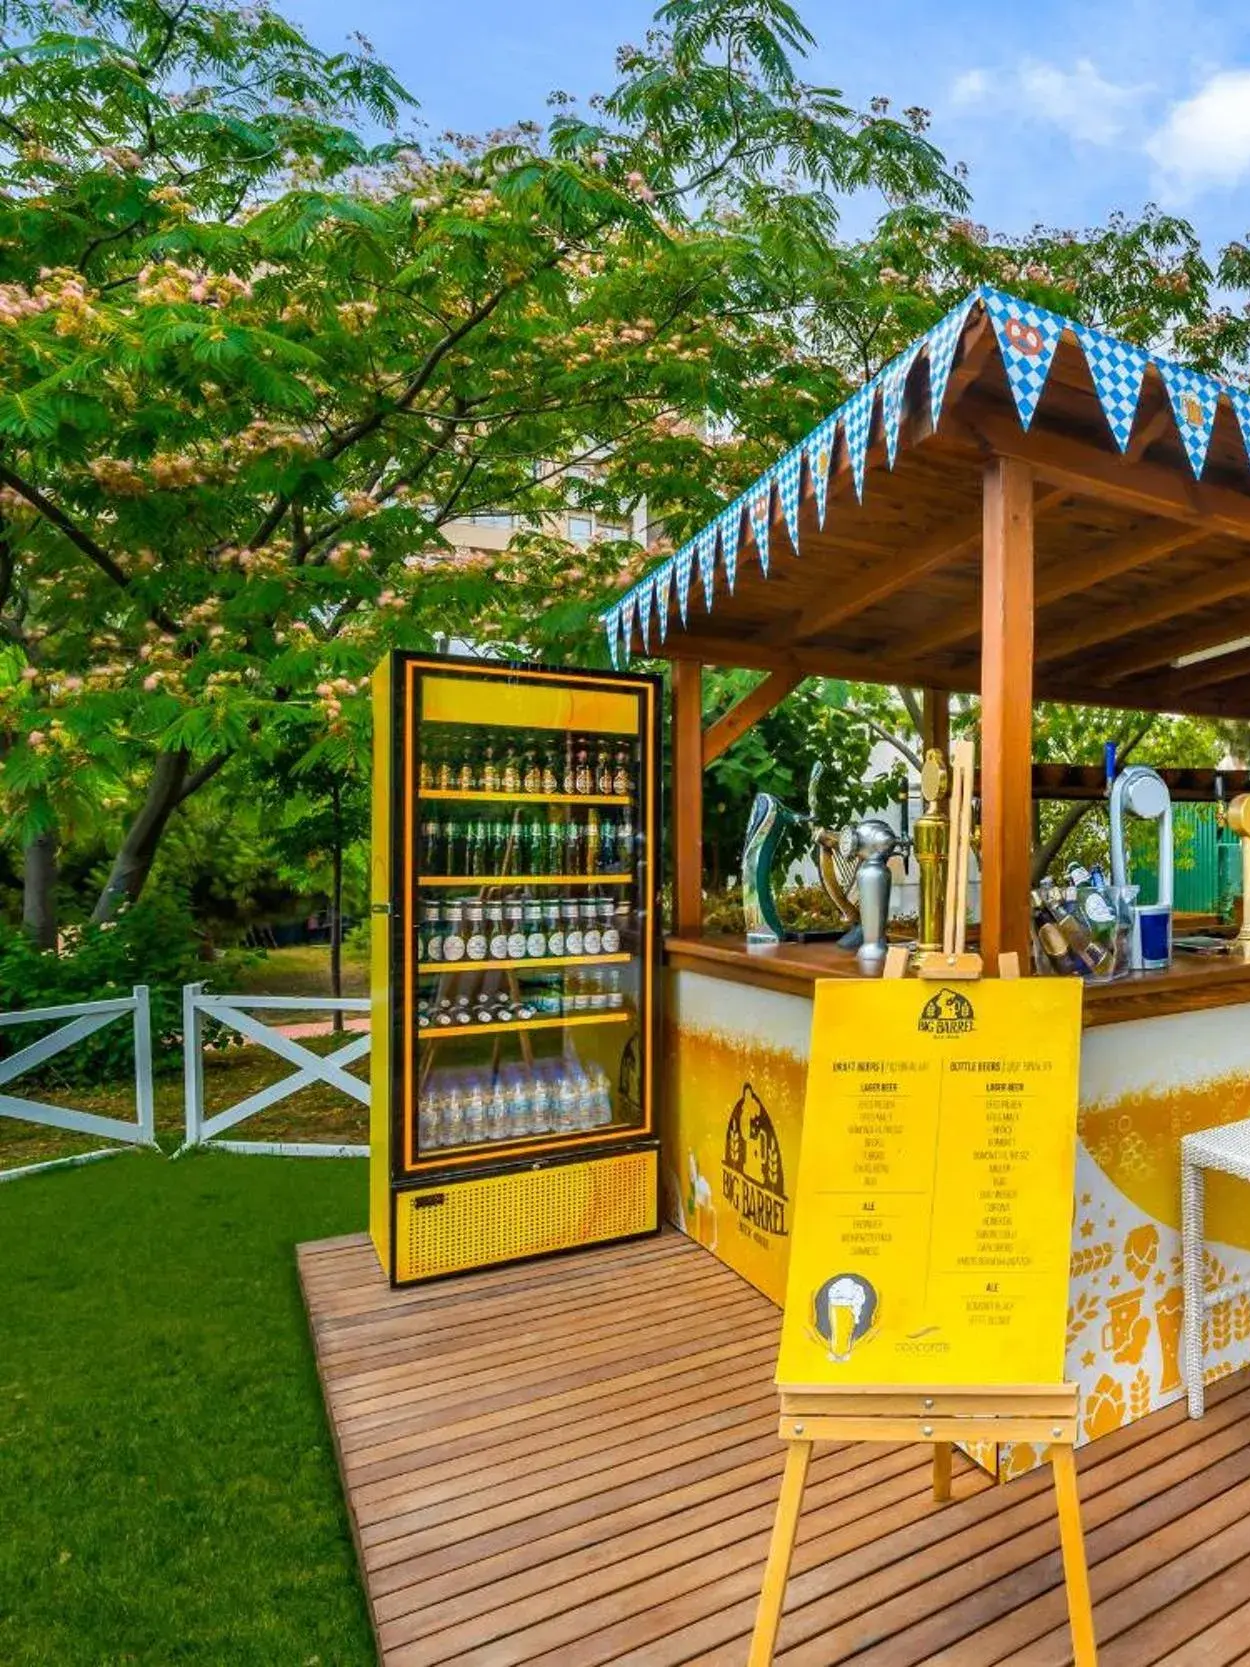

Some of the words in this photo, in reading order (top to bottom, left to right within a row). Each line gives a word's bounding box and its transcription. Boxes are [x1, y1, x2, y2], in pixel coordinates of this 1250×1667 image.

[722, 1169, 739, 1211] BIG
[742, 1179, 789, 1237] BARREL
[985, 1282, 1000, 1292] ALE
